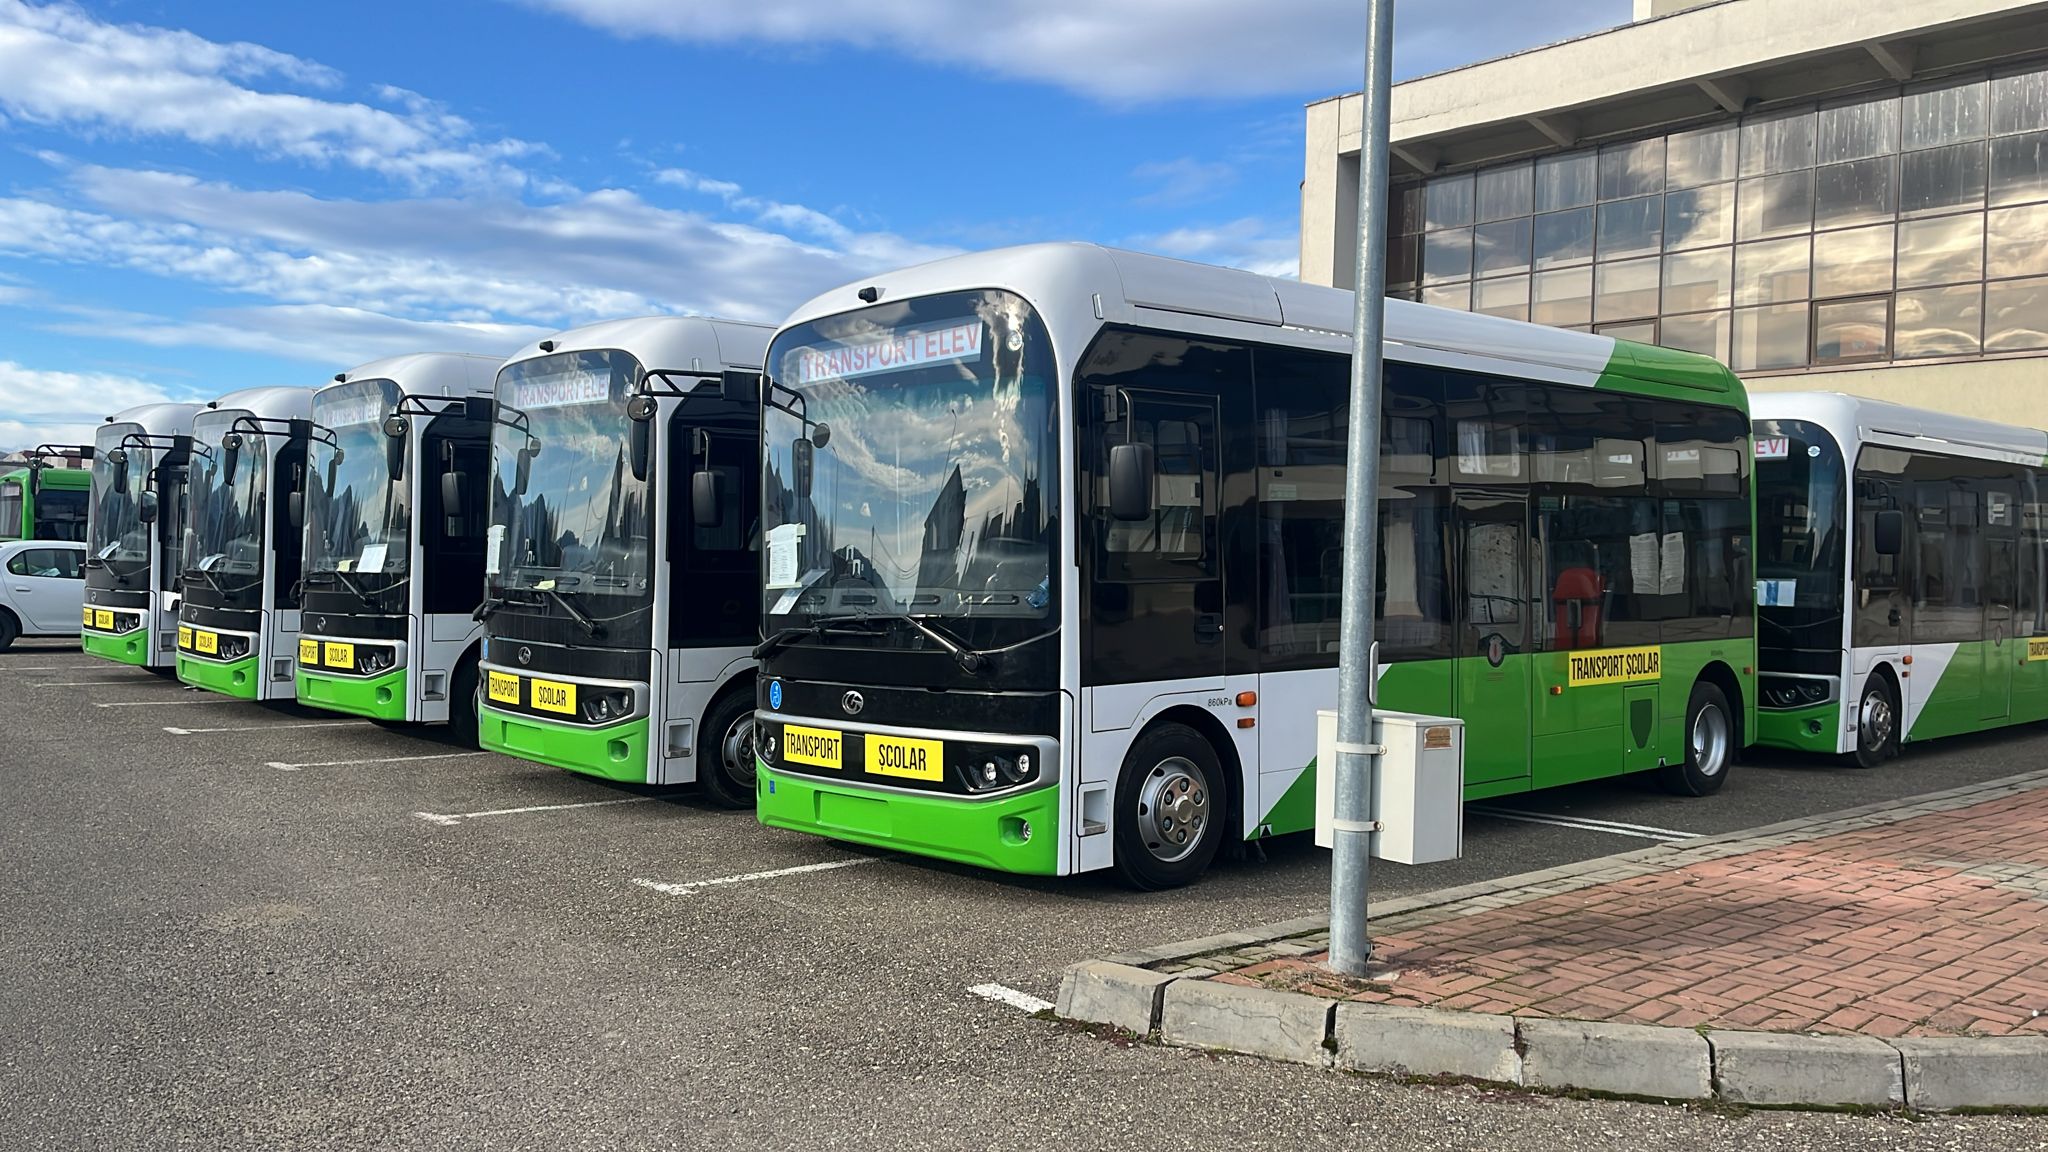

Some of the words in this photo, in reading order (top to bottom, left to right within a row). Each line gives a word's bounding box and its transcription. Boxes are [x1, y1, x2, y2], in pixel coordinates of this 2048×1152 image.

[803, 333, 919, 380] TRANSPORT
[516, 382, 581, 408] TRANSPORT
[1571, 655, 1625, 680] TRANSPORT
[1626, 652, 1659, 680] ȘCOLAR
[490, 677, 518, 698] TRANSPORT
[538, 686, 567, 707] ȘCOLAR
[785, 732, 840, 761] TRANSPORT
[878, 743, 927, 772] ȘCOLAR
